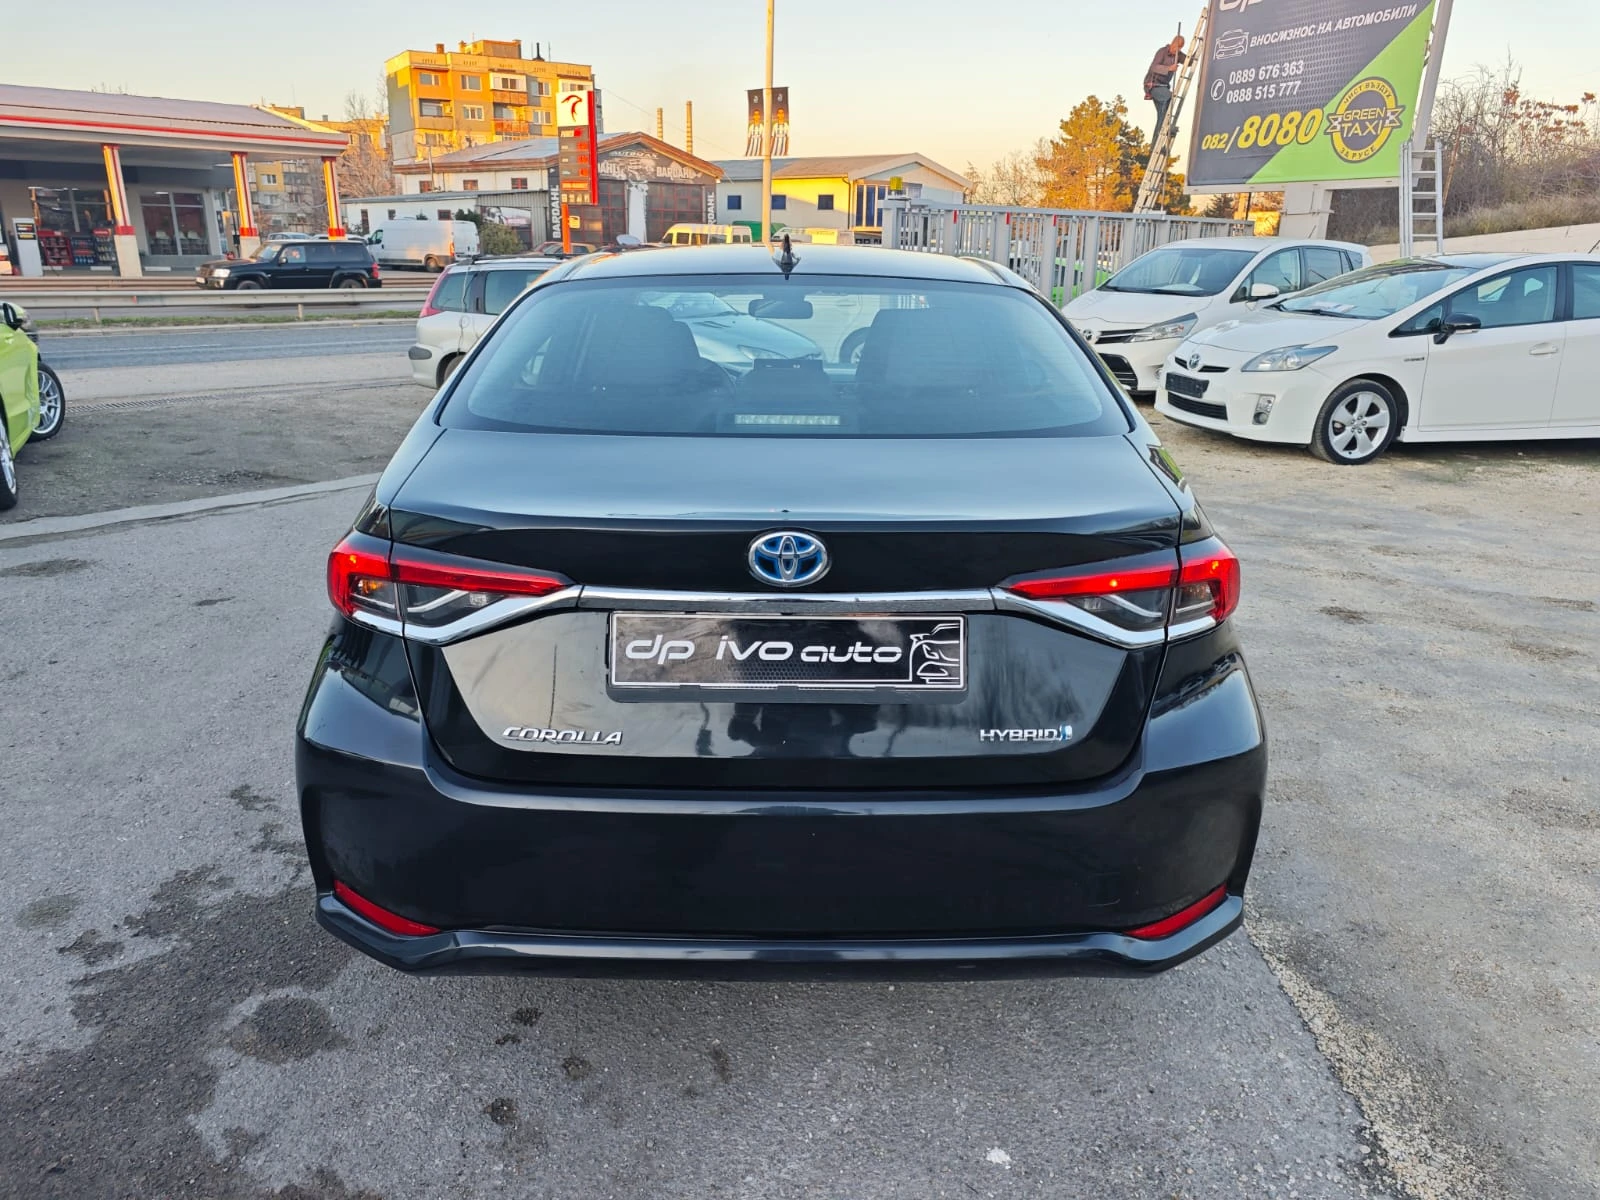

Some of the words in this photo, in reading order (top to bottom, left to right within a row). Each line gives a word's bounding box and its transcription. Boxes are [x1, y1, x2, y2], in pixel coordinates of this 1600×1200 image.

[1317, 21, 1333, 34] НА
[1335, 4, 1417, 30] АВТОМОБИЛИ
[1229, 68, 1256, 85] 0889
[1258, 64, 1280, 79] 676
[1282, 60, 1304, 77] 363
[1226, 86, 1252, 104] 0888
[1255, 83, 1278, 100] 515
[1279, 80, 1302, 97] 777
[1343, 107, 1386, 122] GREEN
[1202, 108, 1324, 153] 082/8080
[1342, 120, 1383, 138] TAXI
[1352, 146, 1376, 160] РУСЕ
[550, 185, 562, 239] BARDAHL
[707, 191, 717, 225] RDAHL
[625, 634, 695, 665] dp
[716, 635, 794, 661] ivo
[800, 641, 903, 664] auto
[501, 726, 623, 745] COROLLA
[979, 728, 1058, 742] HYBRID
